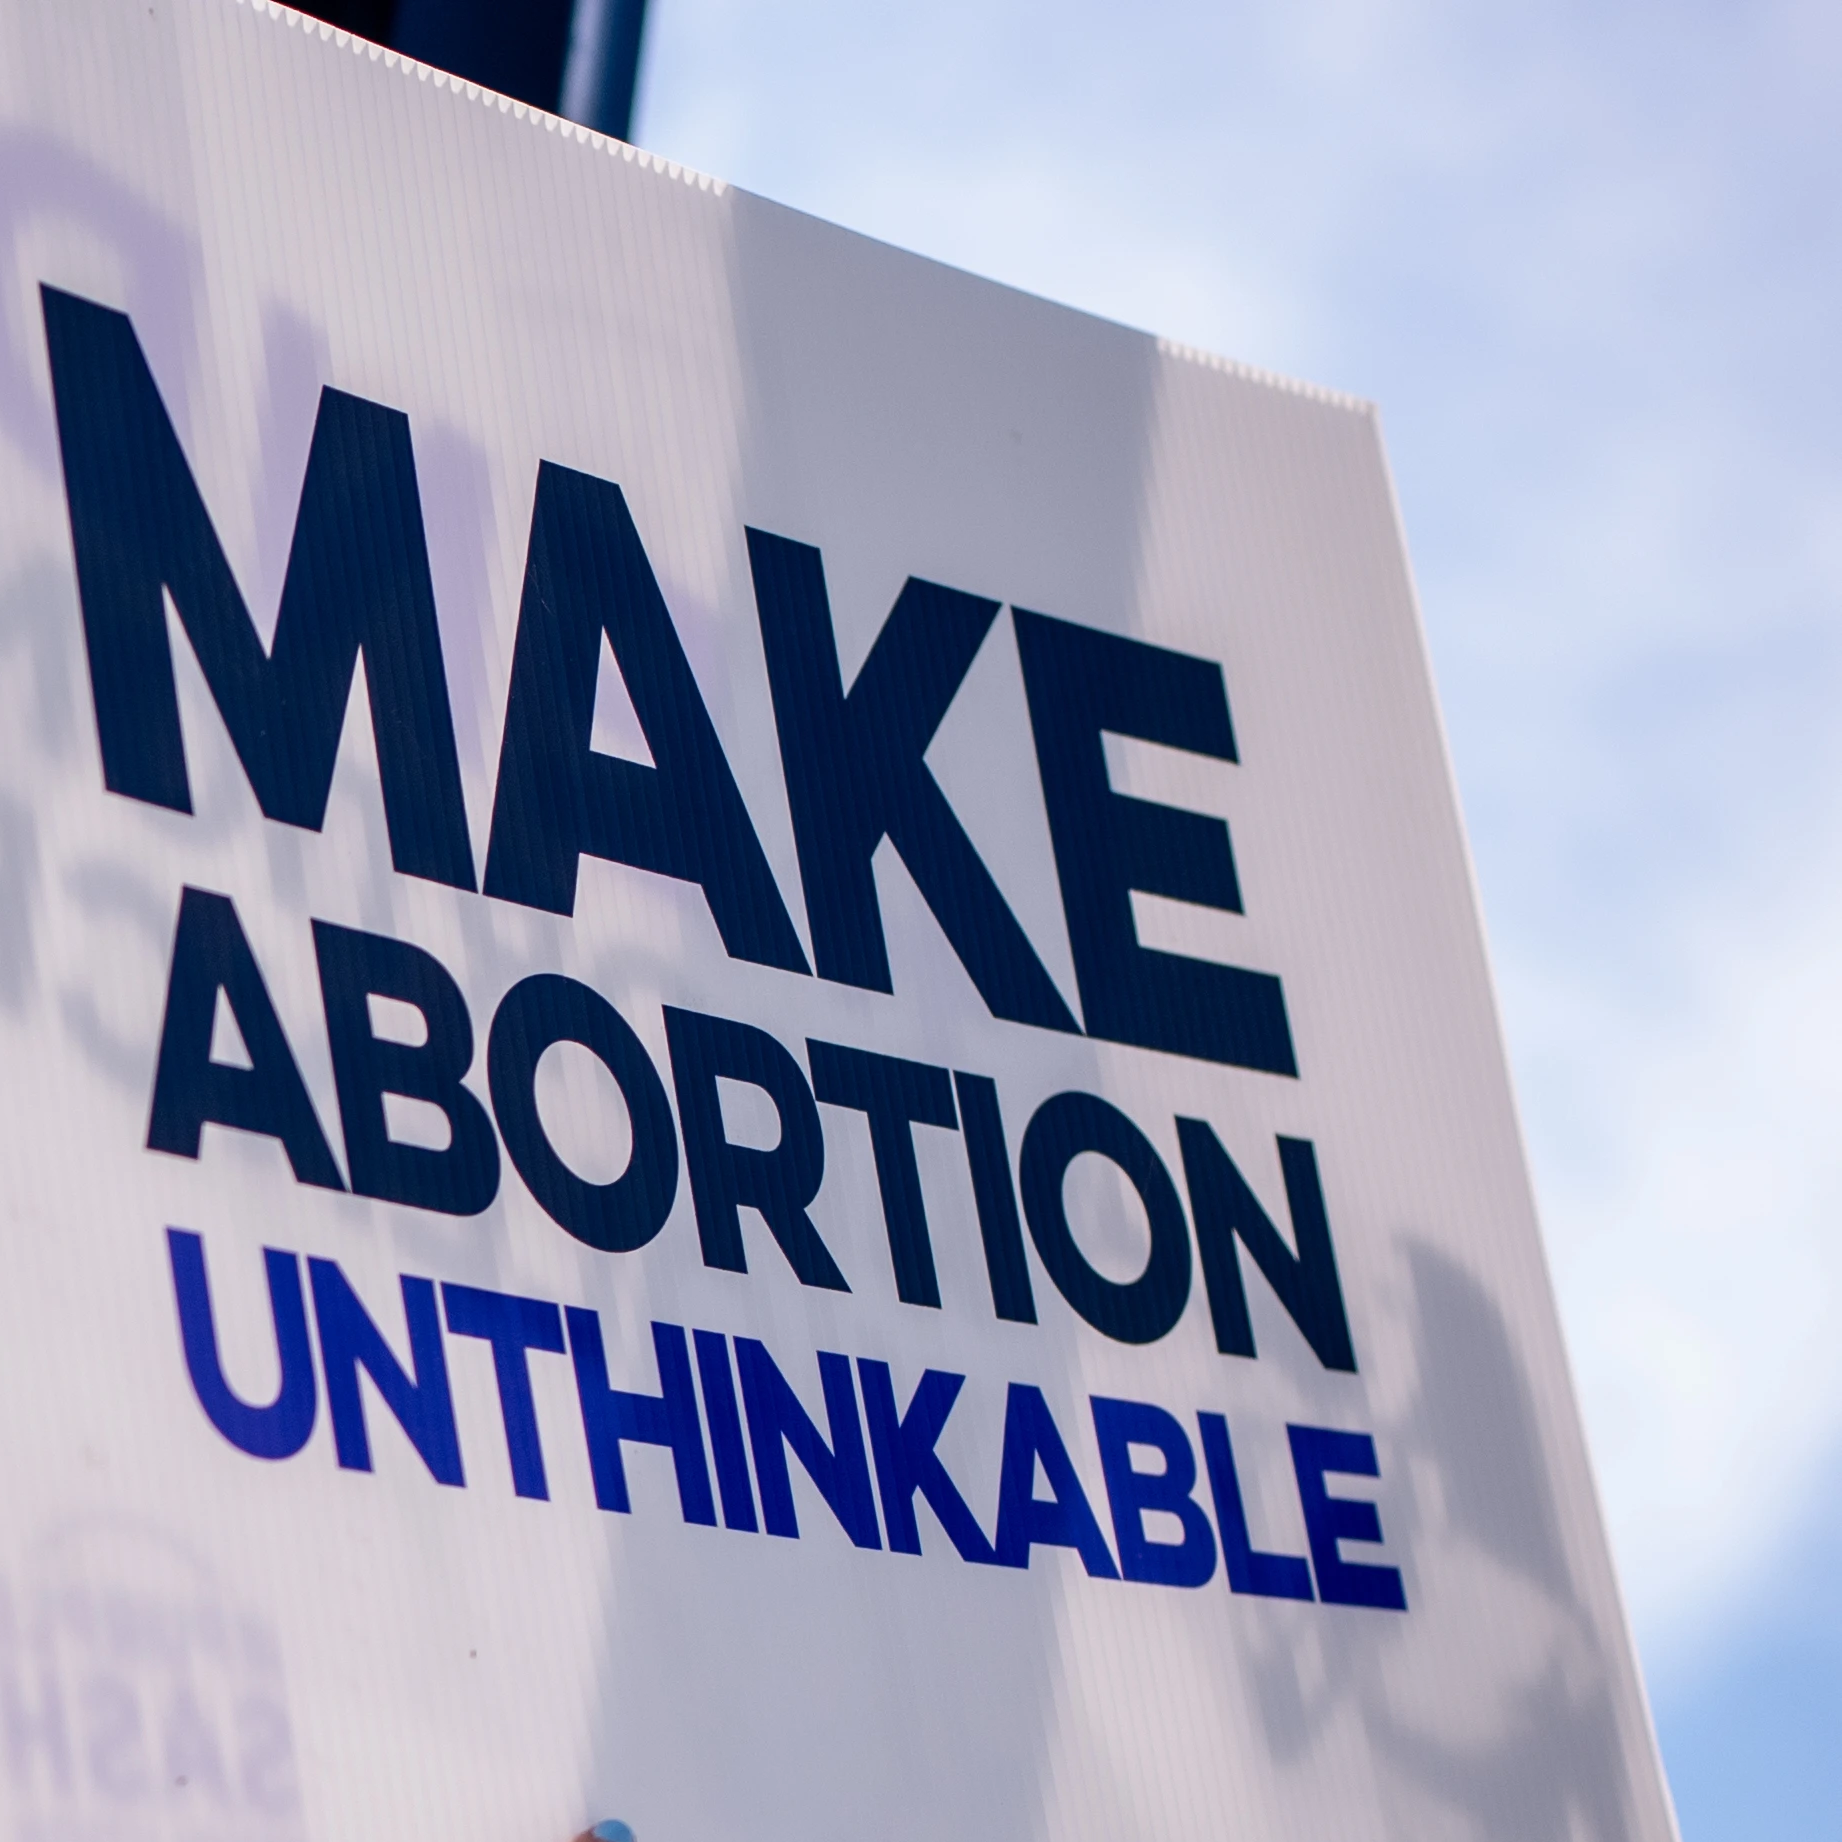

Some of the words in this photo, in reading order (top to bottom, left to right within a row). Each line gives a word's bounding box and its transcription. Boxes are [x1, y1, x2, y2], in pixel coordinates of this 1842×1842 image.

[38, 282, 1300, 1080] MAKE
[146, 885, 1359, 1376] ABORTION
[166, 1228, 1408, 1612] UNTHINKABLE
